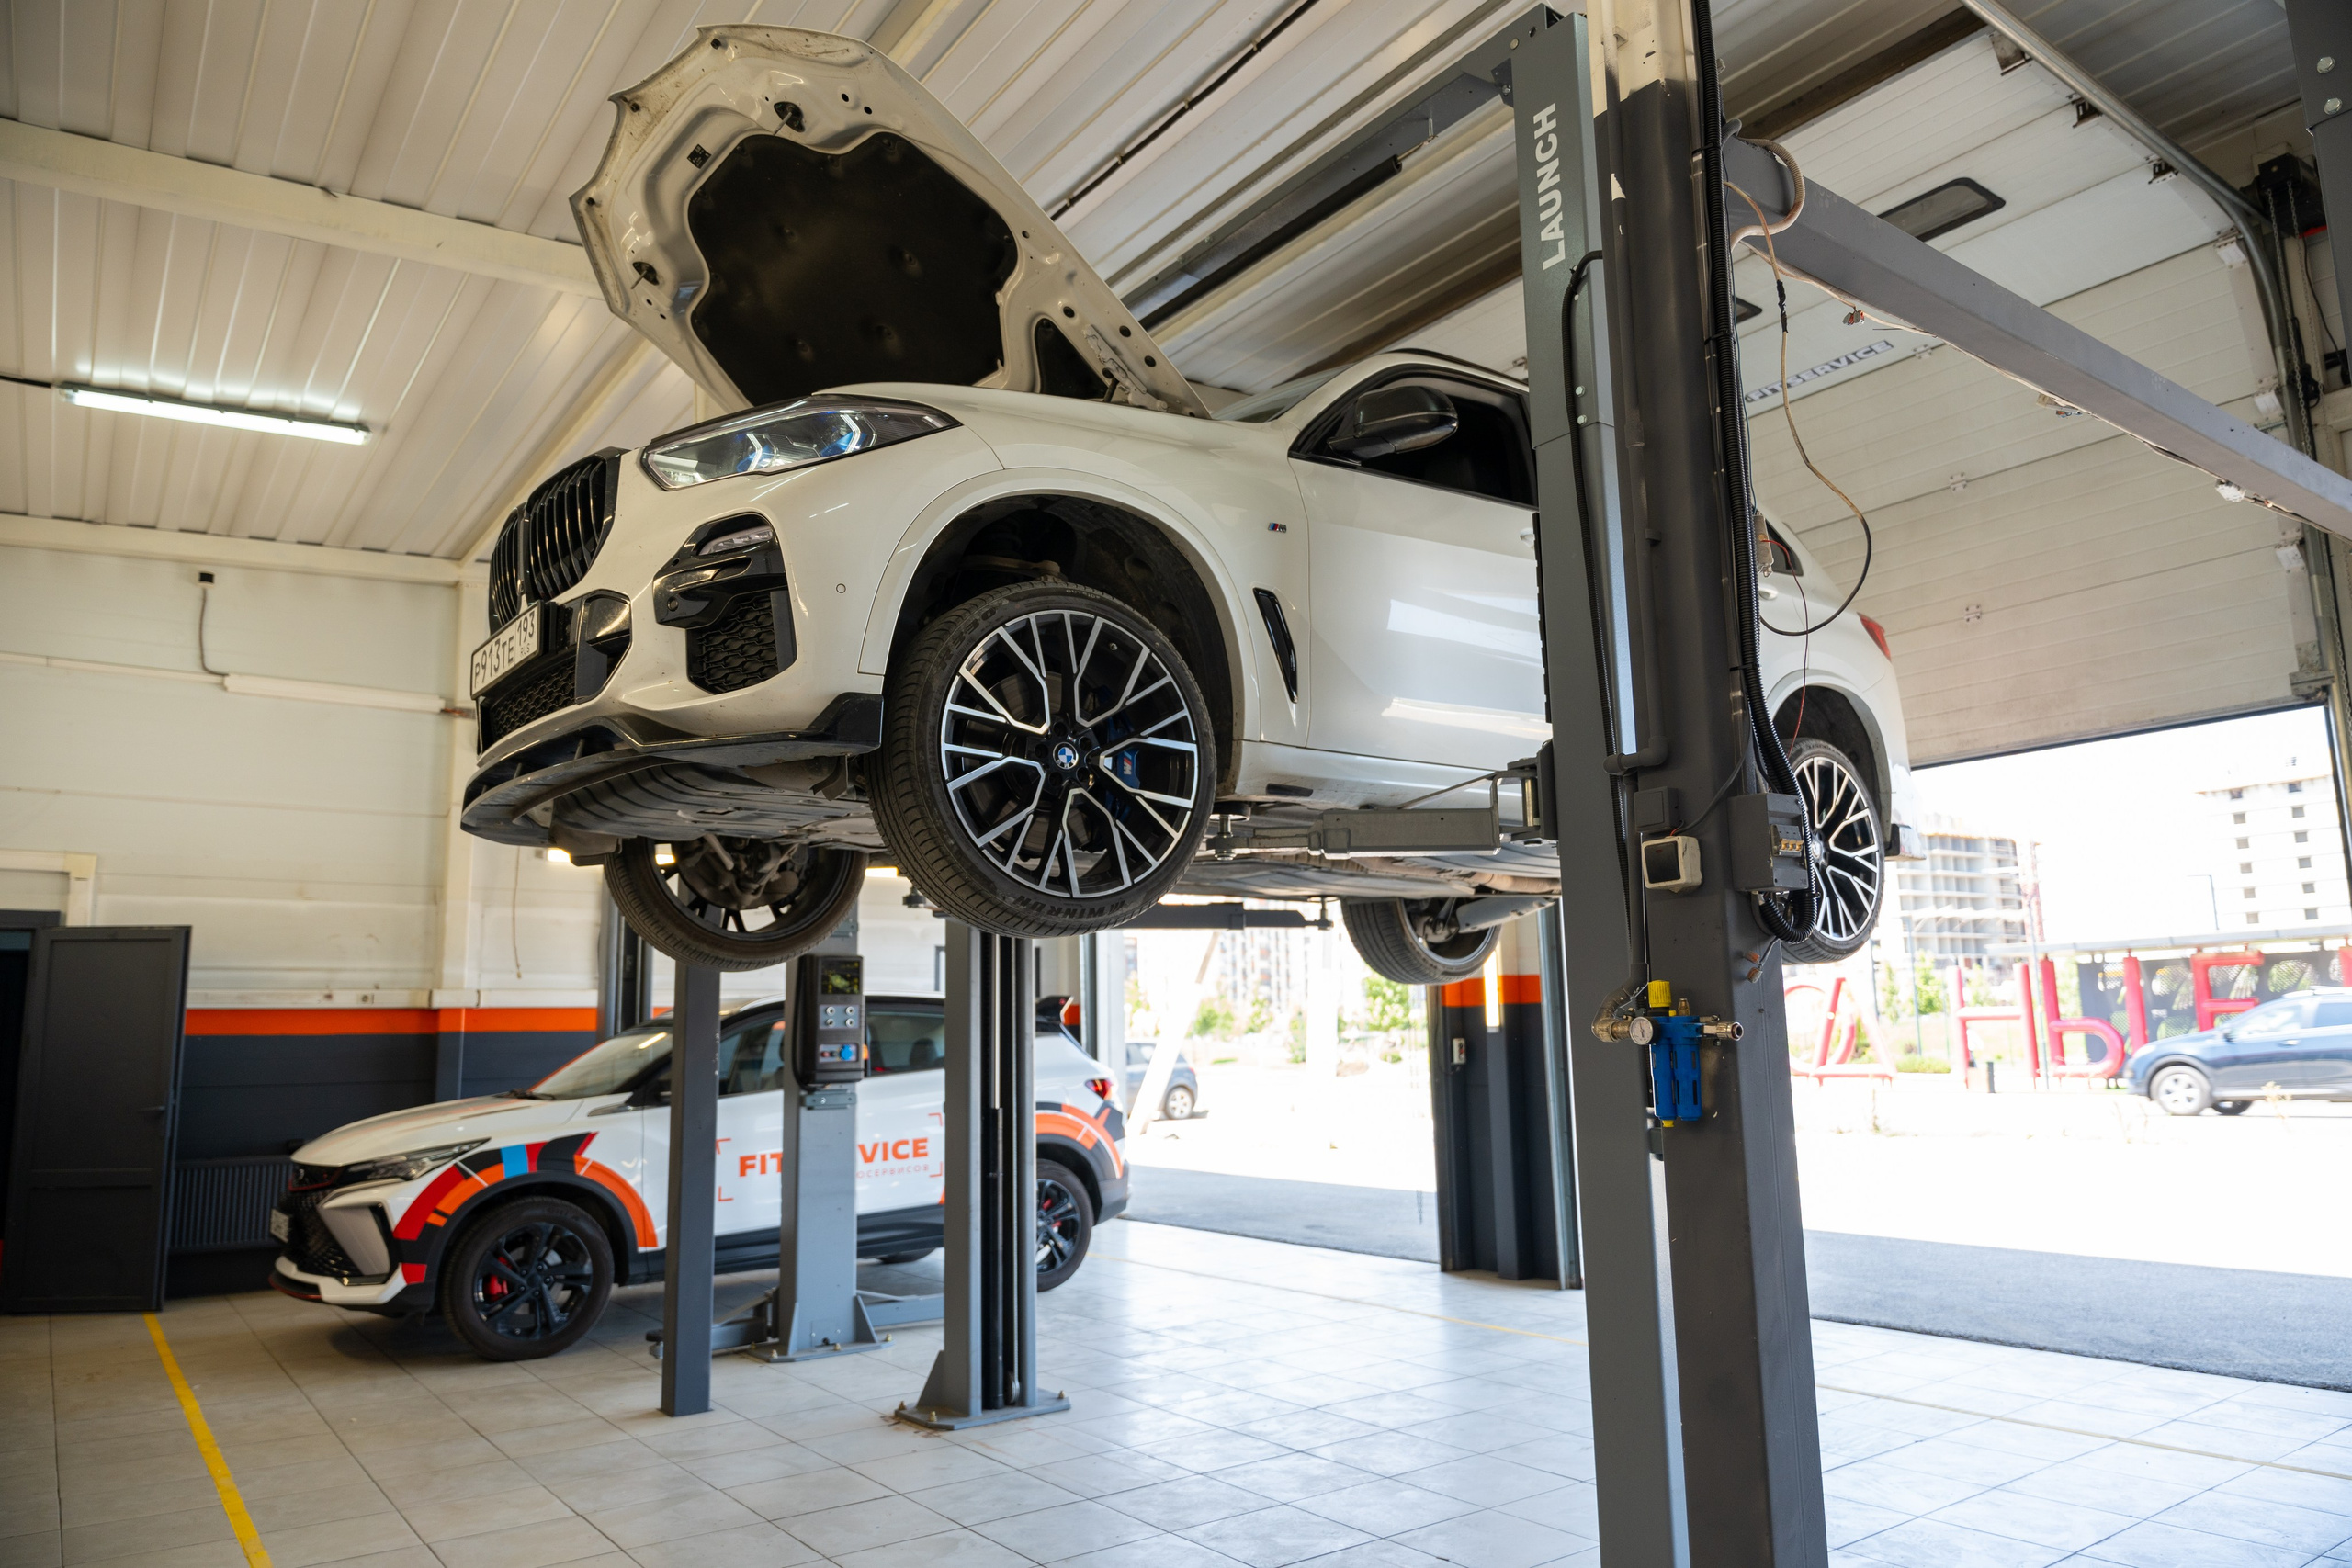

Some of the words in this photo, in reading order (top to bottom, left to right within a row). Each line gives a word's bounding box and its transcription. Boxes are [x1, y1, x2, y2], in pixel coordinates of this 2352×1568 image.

[1532, 102, 1566, 270] LAUNCH
[1747, 340, 1894, 402] FITSERVICE
[517, 610, 535, 647] 193
[520, 643, 530, 657] RUS
[1012, 896, 1105, 919] WINRUN
[855, 1164, 929, 1179] ОСЕРВИСОВ
